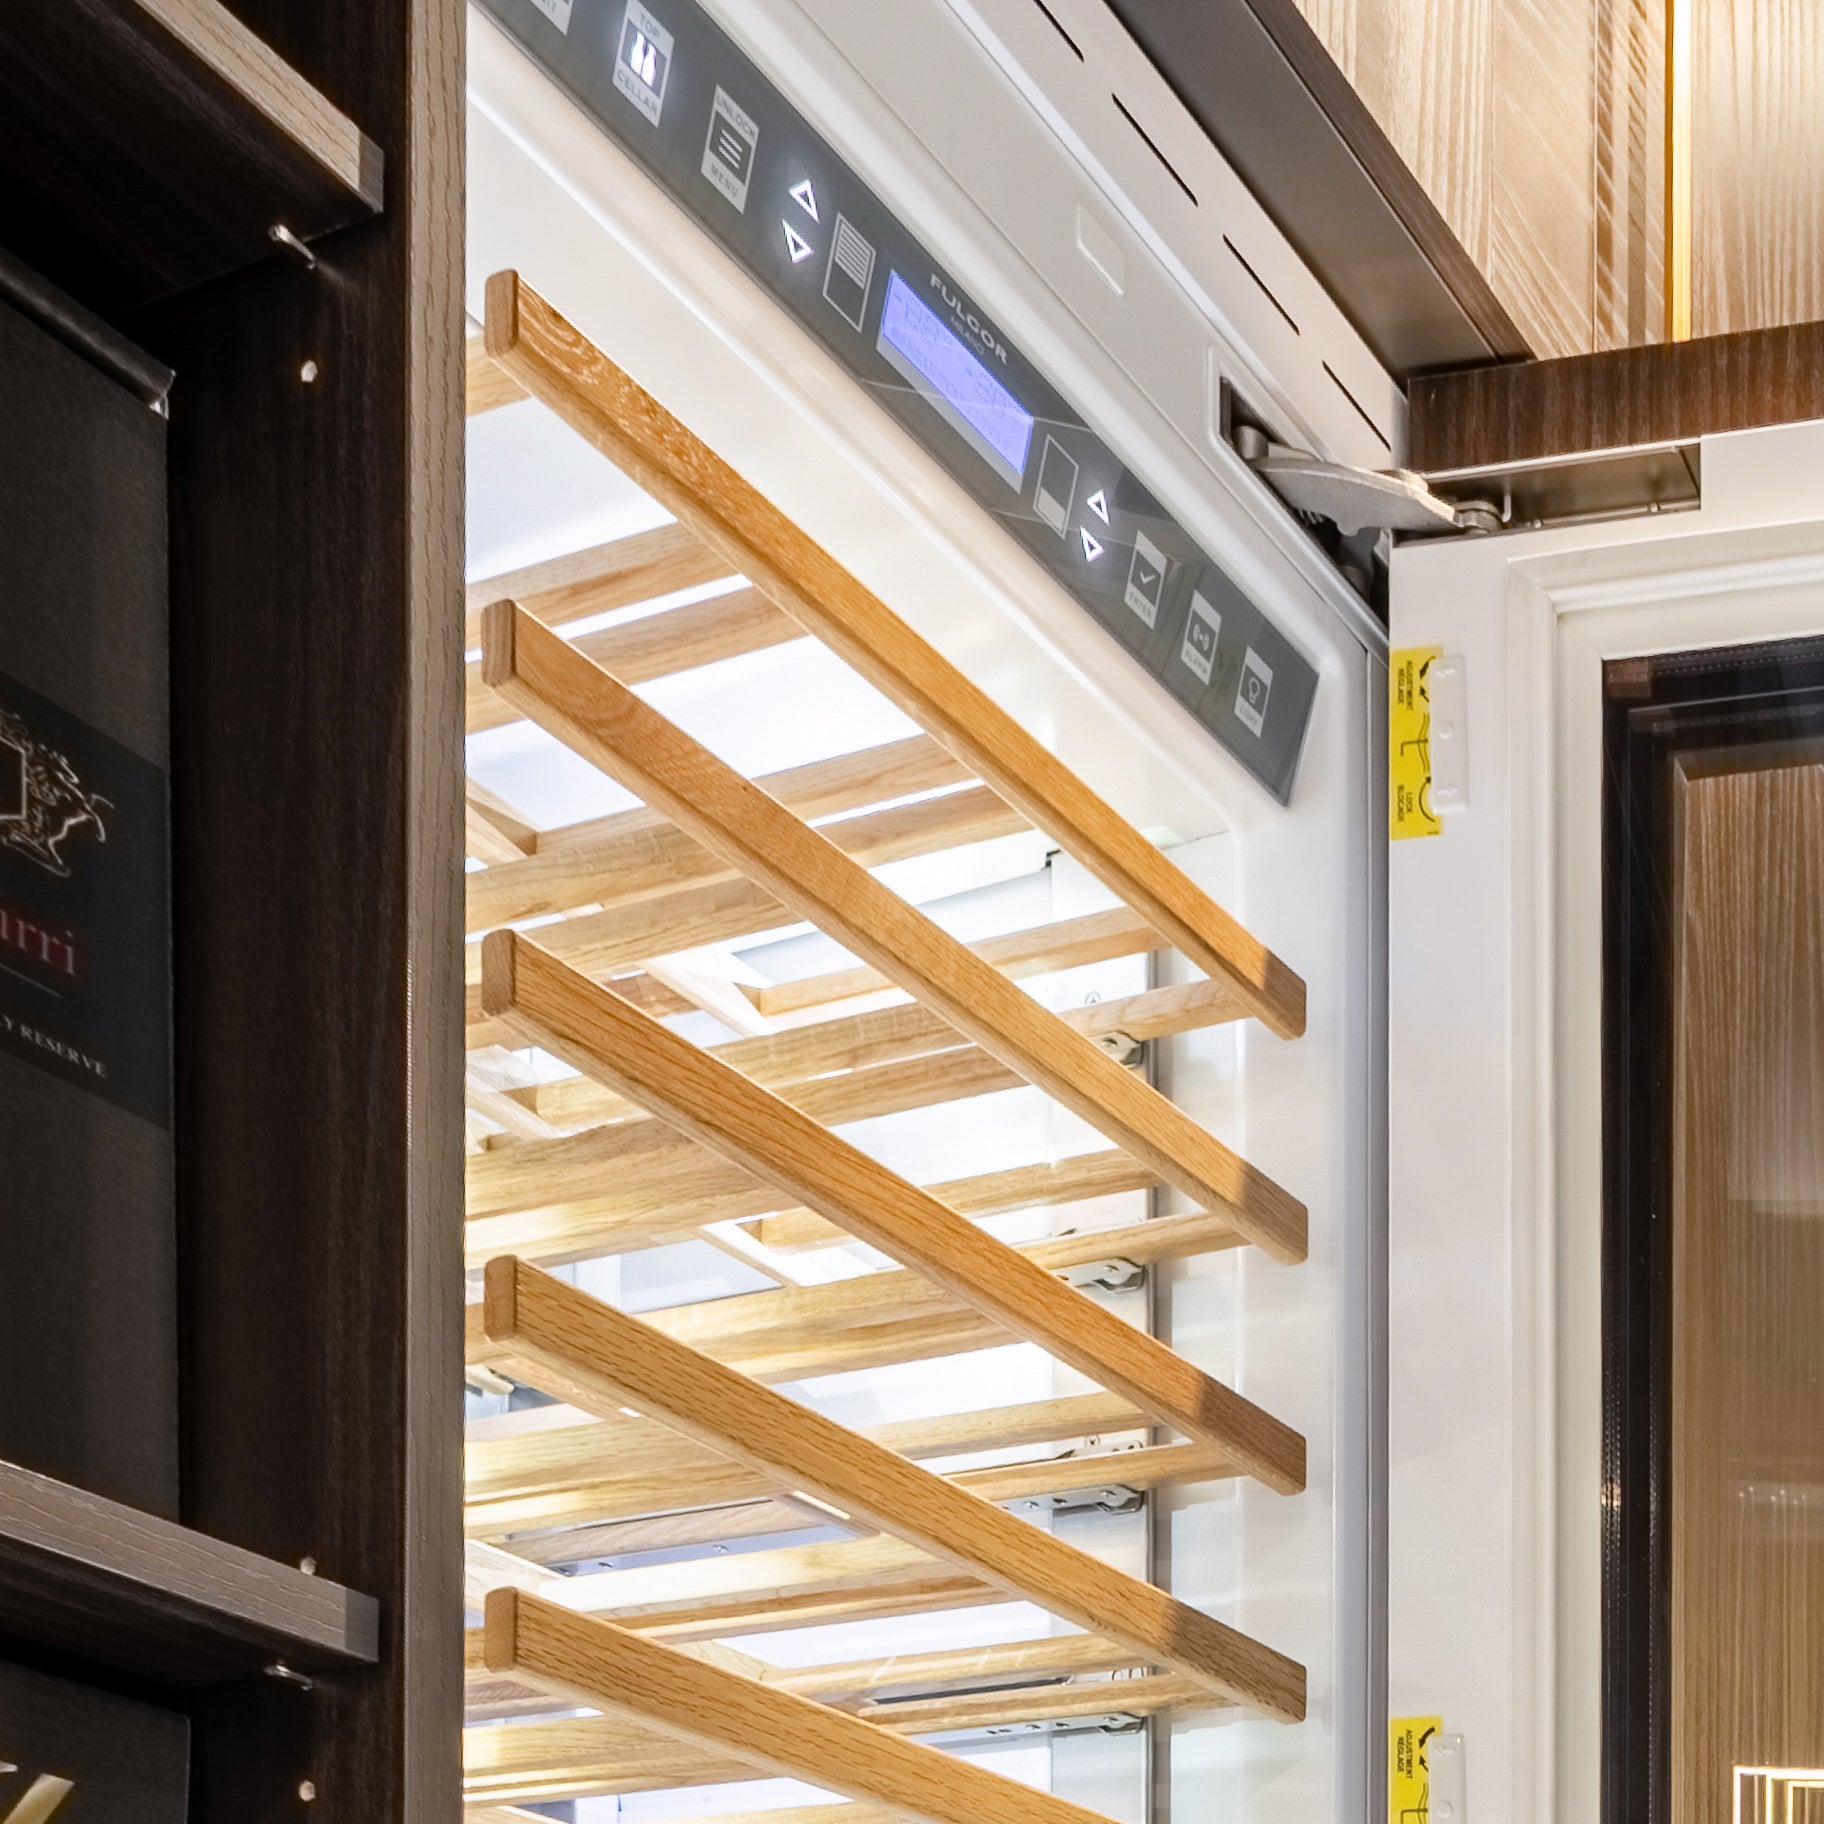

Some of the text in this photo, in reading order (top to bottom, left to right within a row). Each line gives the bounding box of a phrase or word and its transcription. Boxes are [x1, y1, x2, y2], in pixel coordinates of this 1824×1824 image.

[639, 12, 661, 38] TOP
[616, 69, 659, 115] CELLAR
[716, 95, 757, 138] UNLOCK
[710, 164, 739, 198] MENU
[930, 272, 1009, 365] FULGOR
[20, 1023, 107, 1079] RESERVE
[1405, 1729, 1413, 1780] ADJUSTMENT
